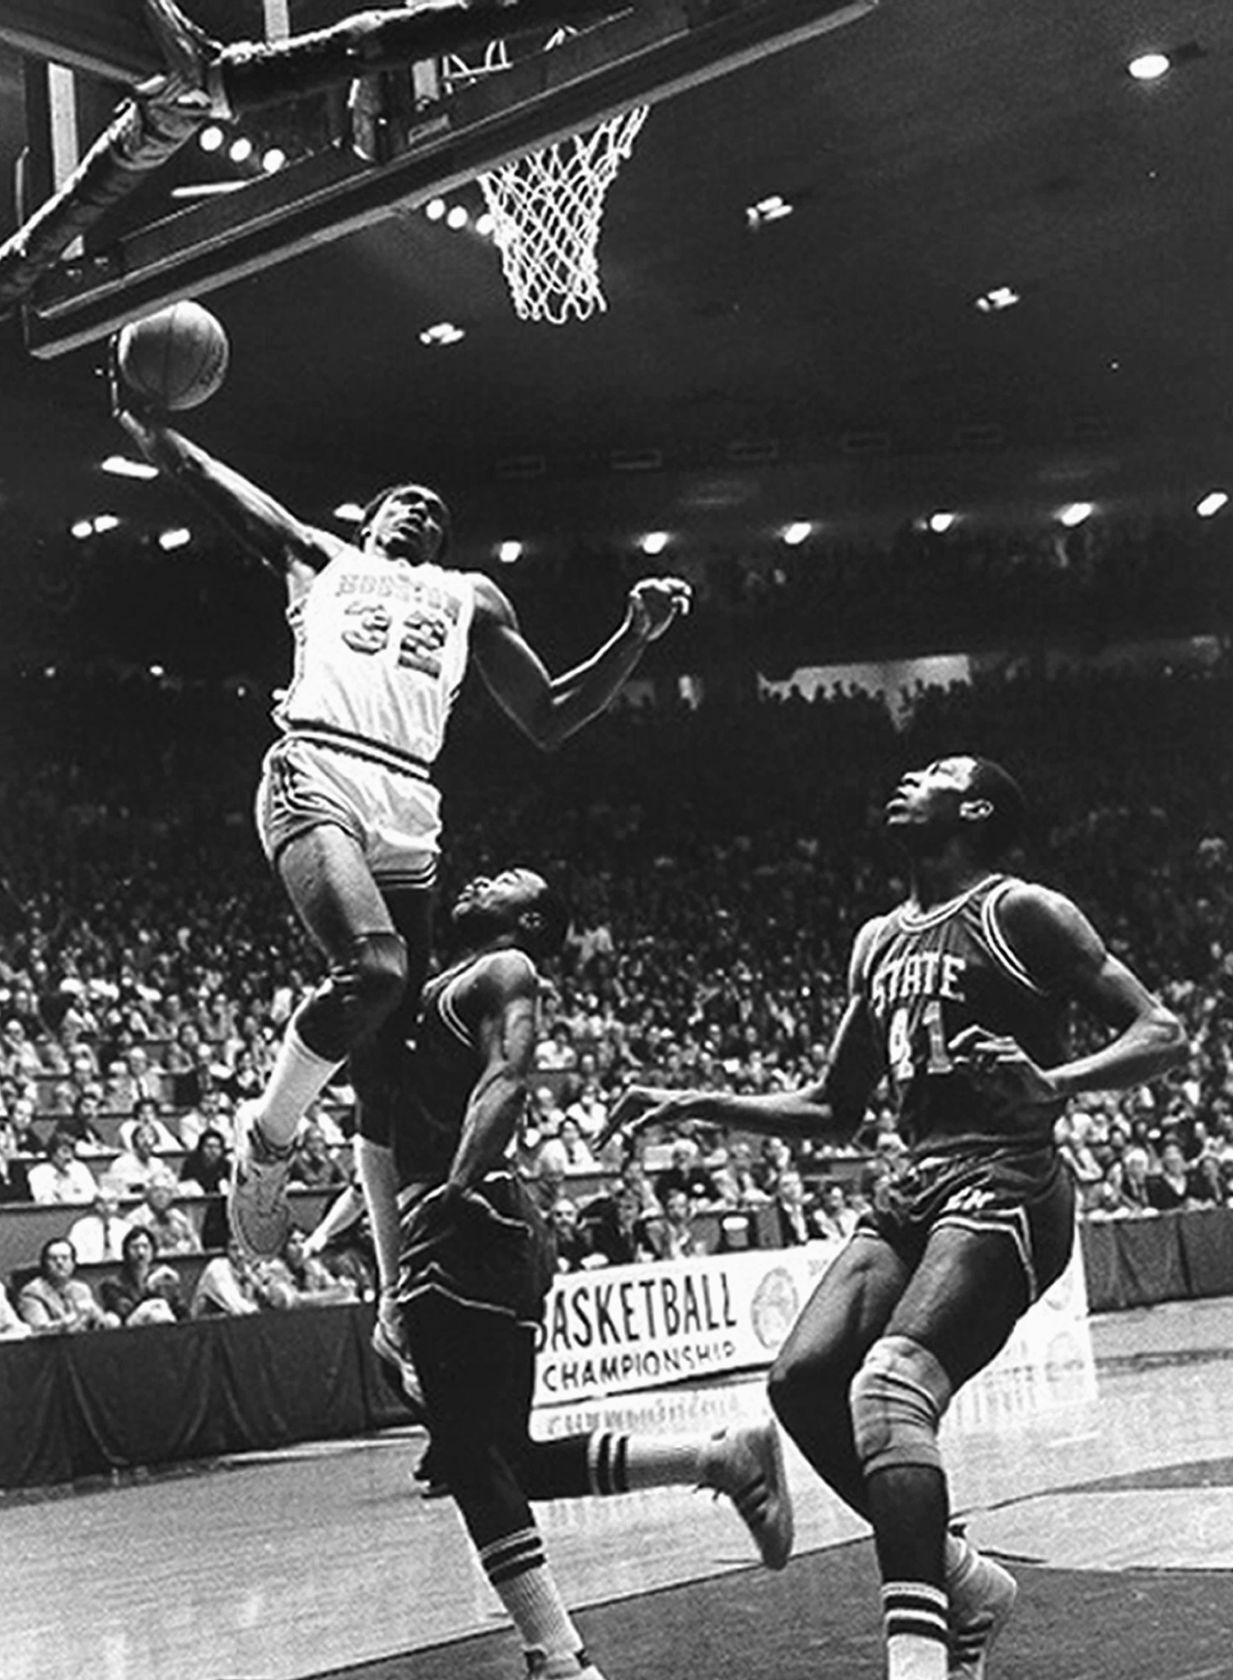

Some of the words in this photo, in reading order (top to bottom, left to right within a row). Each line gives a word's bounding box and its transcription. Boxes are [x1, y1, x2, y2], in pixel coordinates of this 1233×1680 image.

[341, 601, 448, 681] 32
[872, 951, 966, 1018] STATE
[542, 1340, 736, 1392] CHAMPIONSHIP
